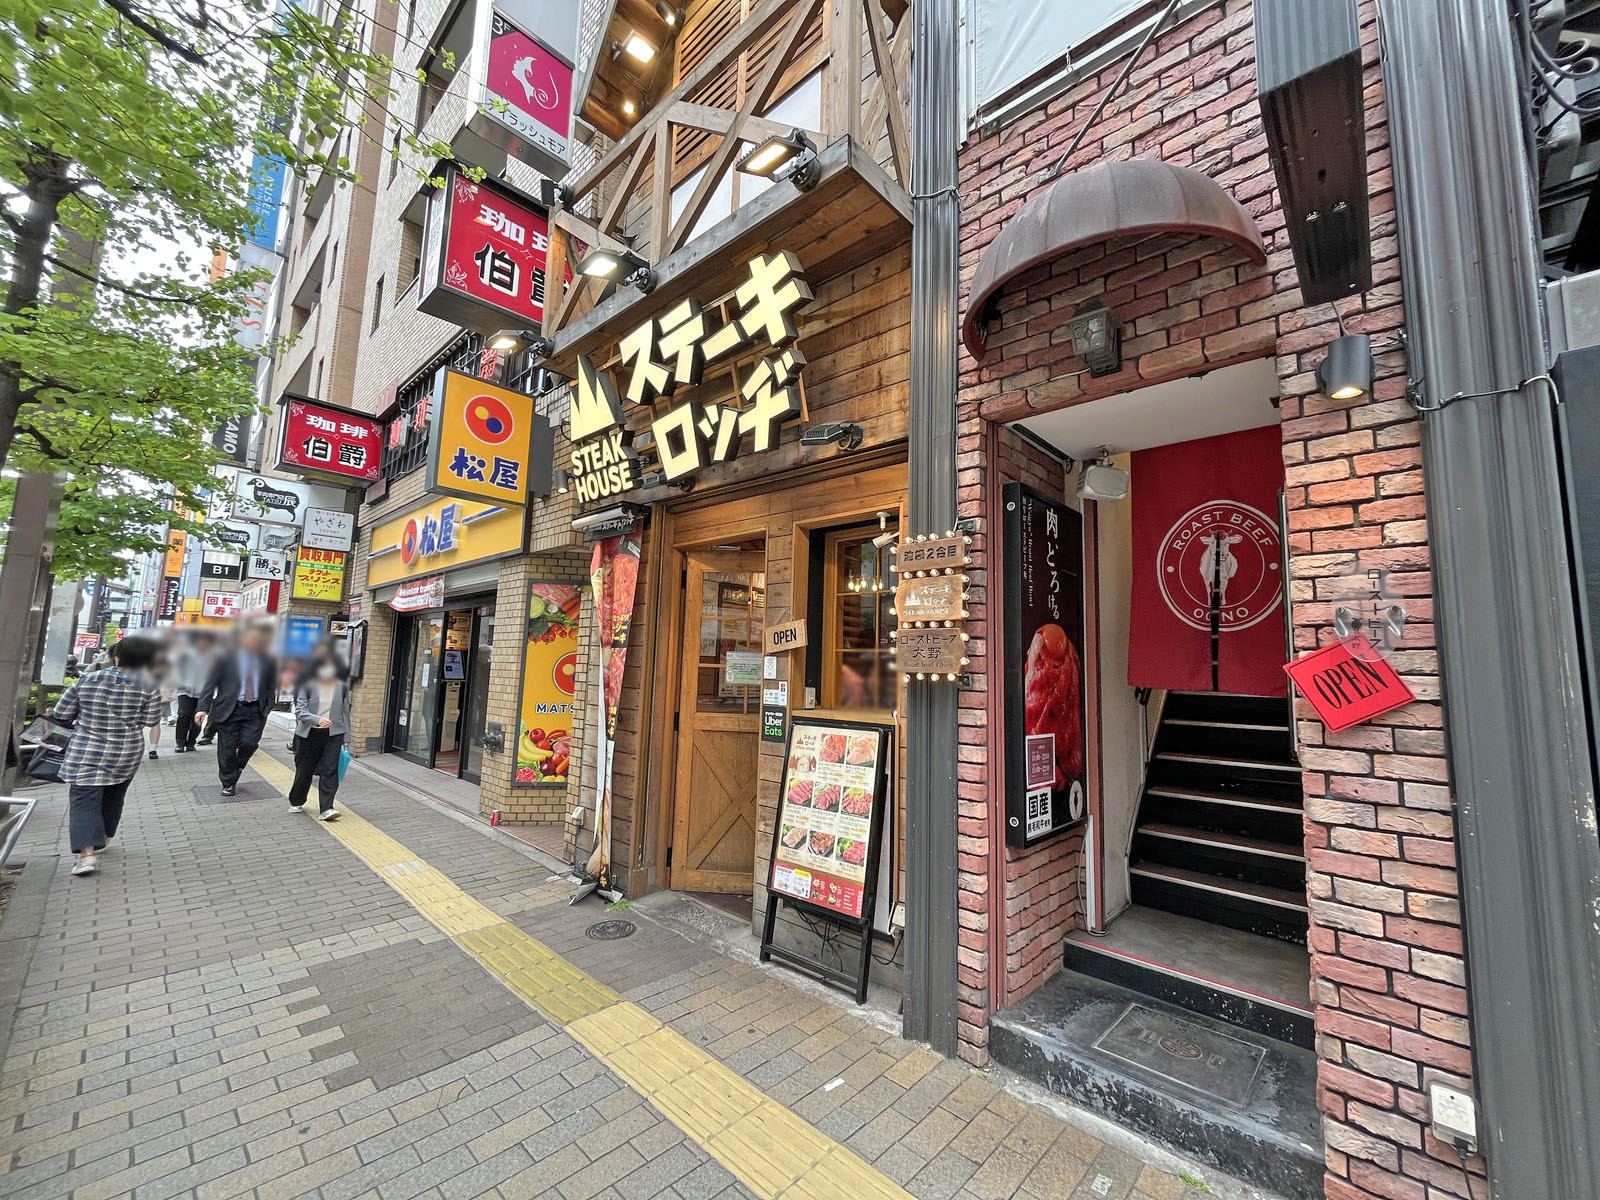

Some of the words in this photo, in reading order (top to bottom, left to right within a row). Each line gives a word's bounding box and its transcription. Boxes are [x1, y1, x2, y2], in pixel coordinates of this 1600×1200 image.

[492, 16, 511, 35] 3F
[619, 251, 803, 405] ステーキ
[306, 413, 369, 439] 珈琲
[652, 349, 795, 480] ロッヂ
[302, 435, 367, 470] 伯爵
[571, 431, 628, 477] STEAK
[449, 446, 520, 492] 松屋
[575, 462, 634, 504] HOUSE
[418, 503, 461, 558] 松屋
[1173, 511, 1224, 550] ROAST
[1230, 512, 1274, 547] BEEF
[212, 565, 230, 575] B1
[207, 596, 234, 606] 回転
[773, 627, 797, 646] OPEN
[901, 634, 958, 645] ローストビーフ
[912, 646, 942, 659] 大野
[1312, 657, 1389, 709] OPEN
[764, 726, 783, 737] Eats
[765, 716, 783, 726] Uber
[1028, 792, 1049, 819] 国産
